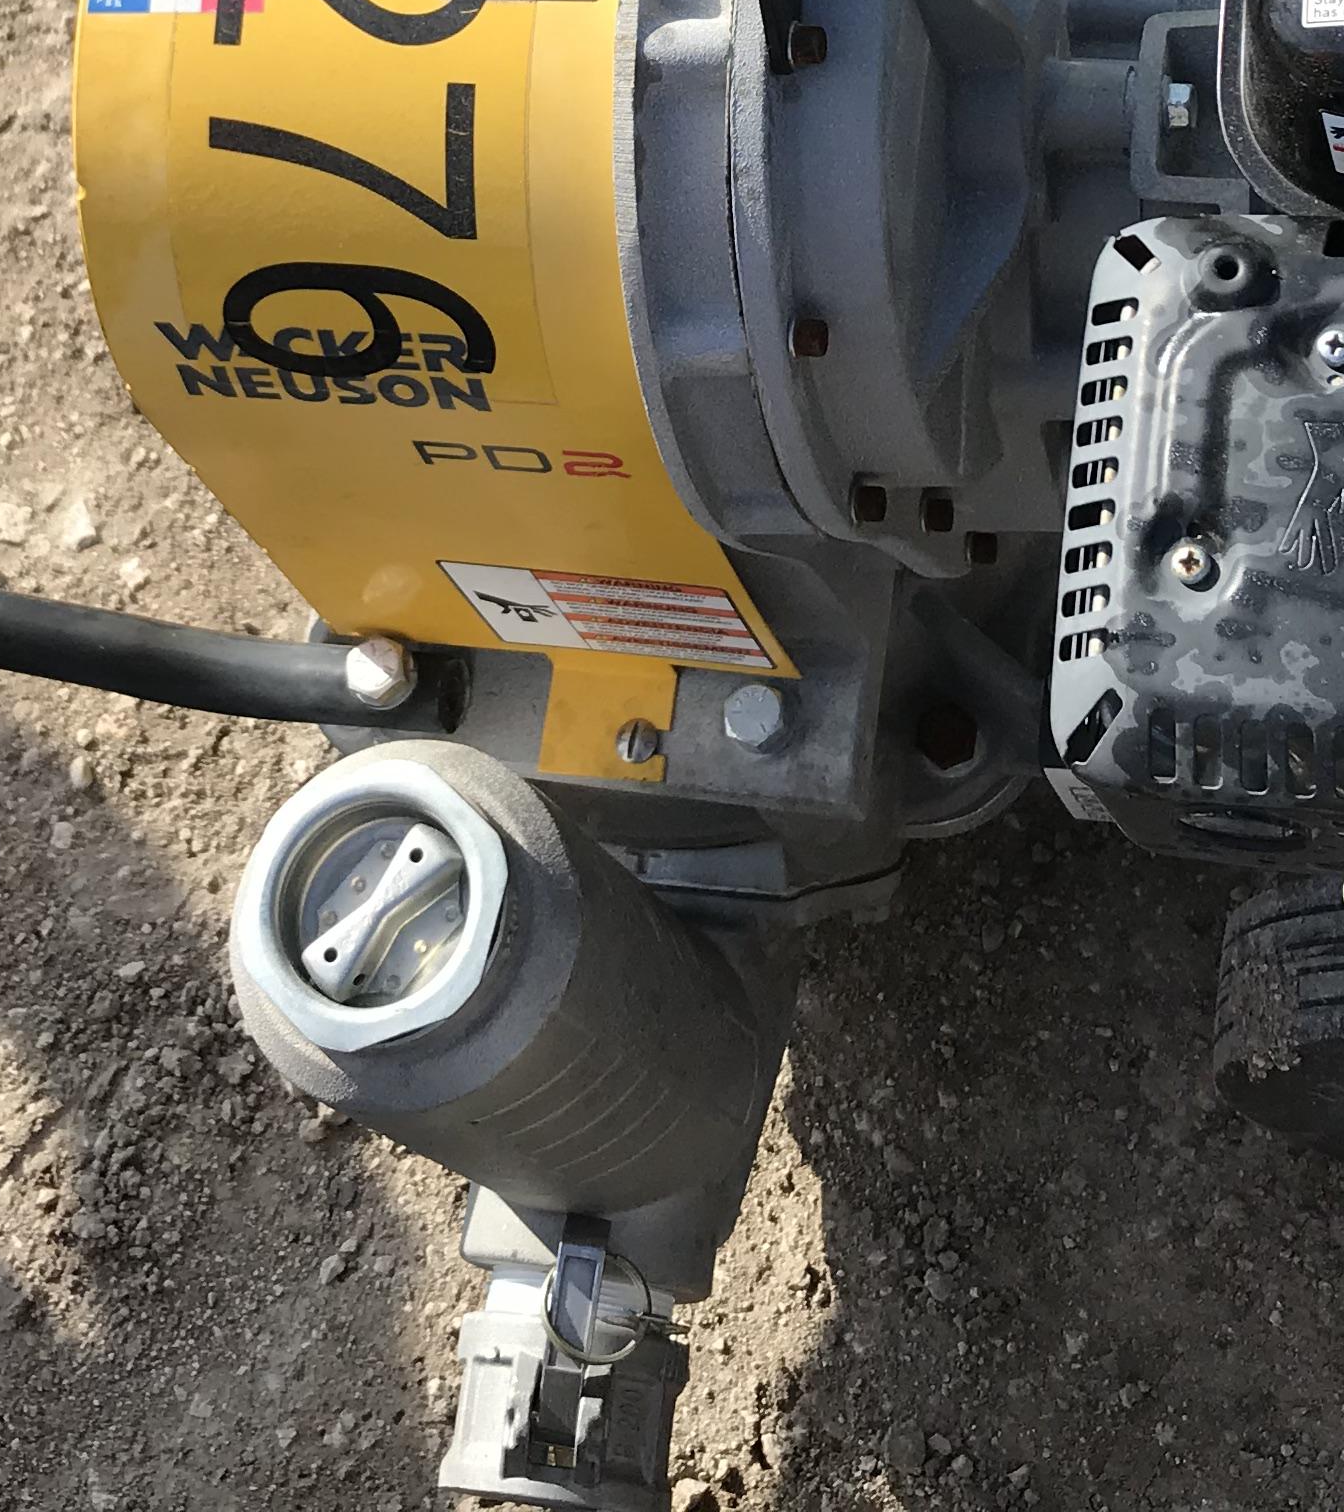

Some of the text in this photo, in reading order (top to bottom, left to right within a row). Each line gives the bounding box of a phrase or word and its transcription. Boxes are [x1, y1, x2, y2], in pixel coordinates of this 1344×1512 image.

[1313, 7, 1338, 18] has
[176, 363, 492, 412] NEUSON
[412, 440, 632, 479] PD2
